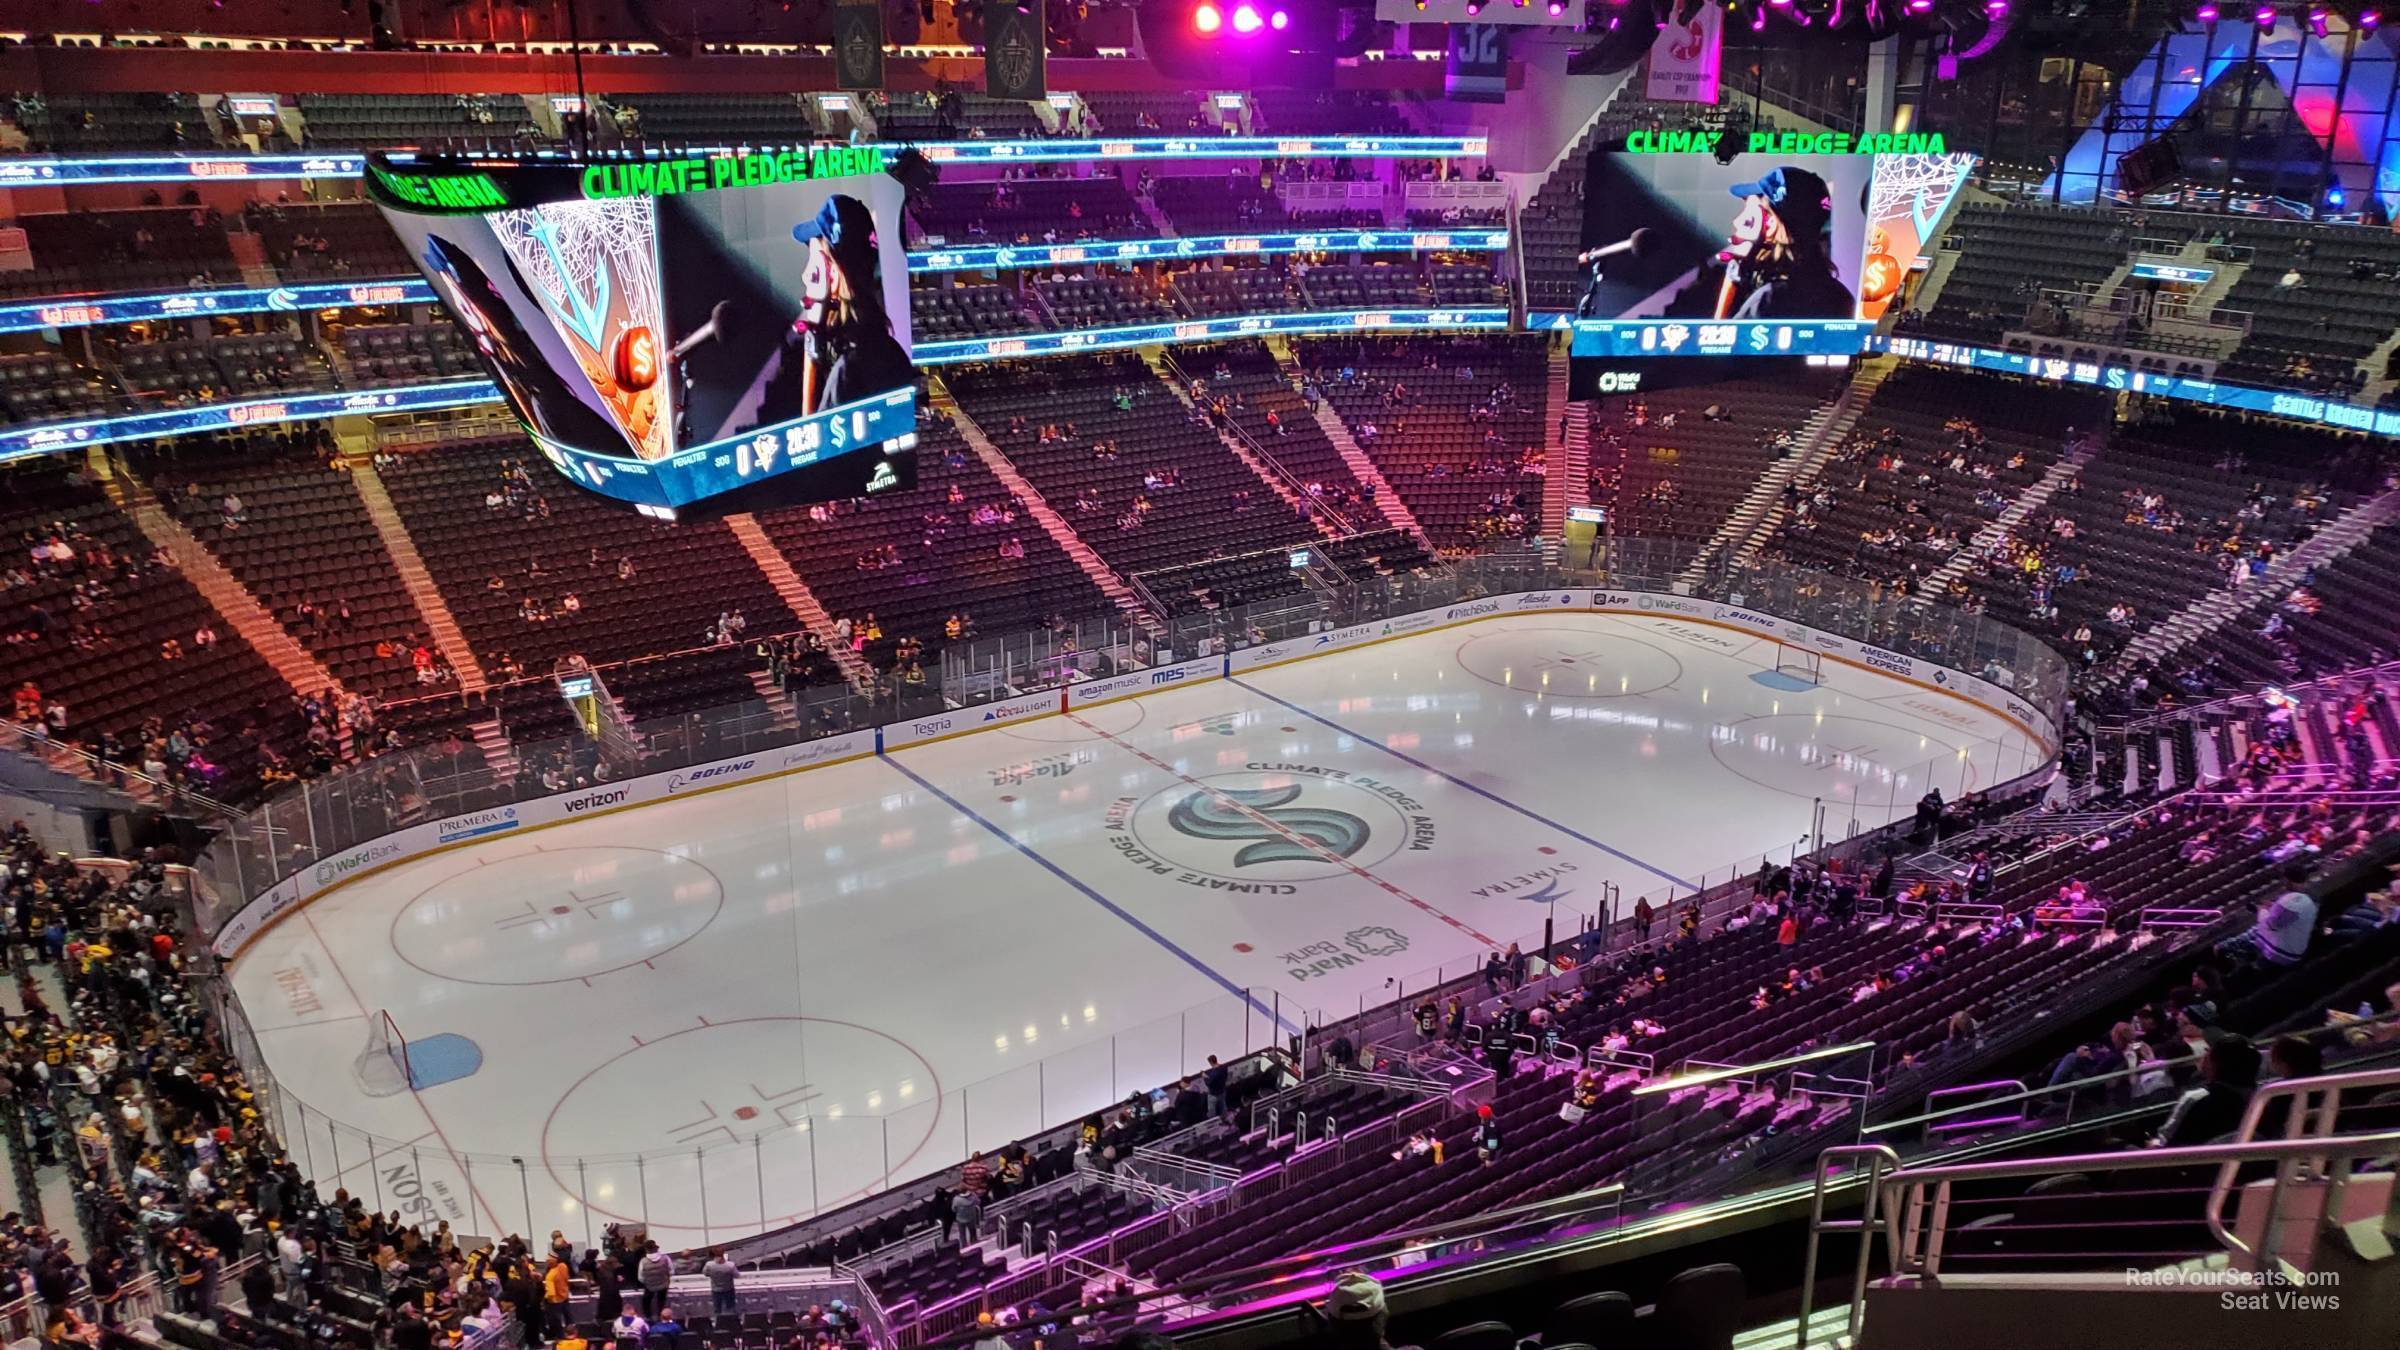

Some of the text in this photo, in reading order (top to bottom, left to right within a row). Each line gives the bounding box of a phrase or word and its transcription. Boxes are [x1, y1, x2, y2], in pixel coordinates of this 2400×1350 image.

[1458, 24, 1499, 63] 32
[1627, 131, 1945, 154] CLIMA PLEDGE ARENA
[583, 148, 884, 199] CLIMATE PLEDGE ARENA
[428, 175, 507, 207] ARENA
[2272, 394, 2324, 419] SEATTLE
[673, 451, 706, 469] PENALTIES
[714, 455, 730, 467] SOG
[736, 445, 749, 476] 0
[852, 411, 864, 440] 0
[613, 462, 648, 475] PENALTIES
[791, 451, 817, 466] PREGAME
[866, 475, 896, 492] SYMETRA
[1455, 600, 1500, 619] PitchBook
[1654, 599, 1680, 611] WaFd
[1729, 610, 1775, 628] BOEING
[1330, 626, 1370, 642] SYMETRA
[1655, 622, 1736, 647] FILSON
[1860, 645, 1912, 667] AMERICAN
[1866, 657, 1912, 676] EXPRESS
[1078, 675, 1142, 700] amazon music
[1152, 667, 1185, 685] MPS
[996, 700, 1052, 720] Coors LIGHT
[912, 718, 952, 737] Tegria
[690, 760, 755, 781] BOEING
[565, 789, 625, 813] verizon
[1246, 762, 1435, 851] CLIMATE PLEDGE ARENA
[439, 813, 498, 834] PREMERA
[336, 842, 401, 873] WaFd Bank
[1104, 797, 1296, 895] CLIMATE PLEDGE ARENA
[1471, 861, 1578, 898] SYMETRA
[1276, 939, 1341, 966] Bank
[1288, 951, 1364, 981] WaFd
